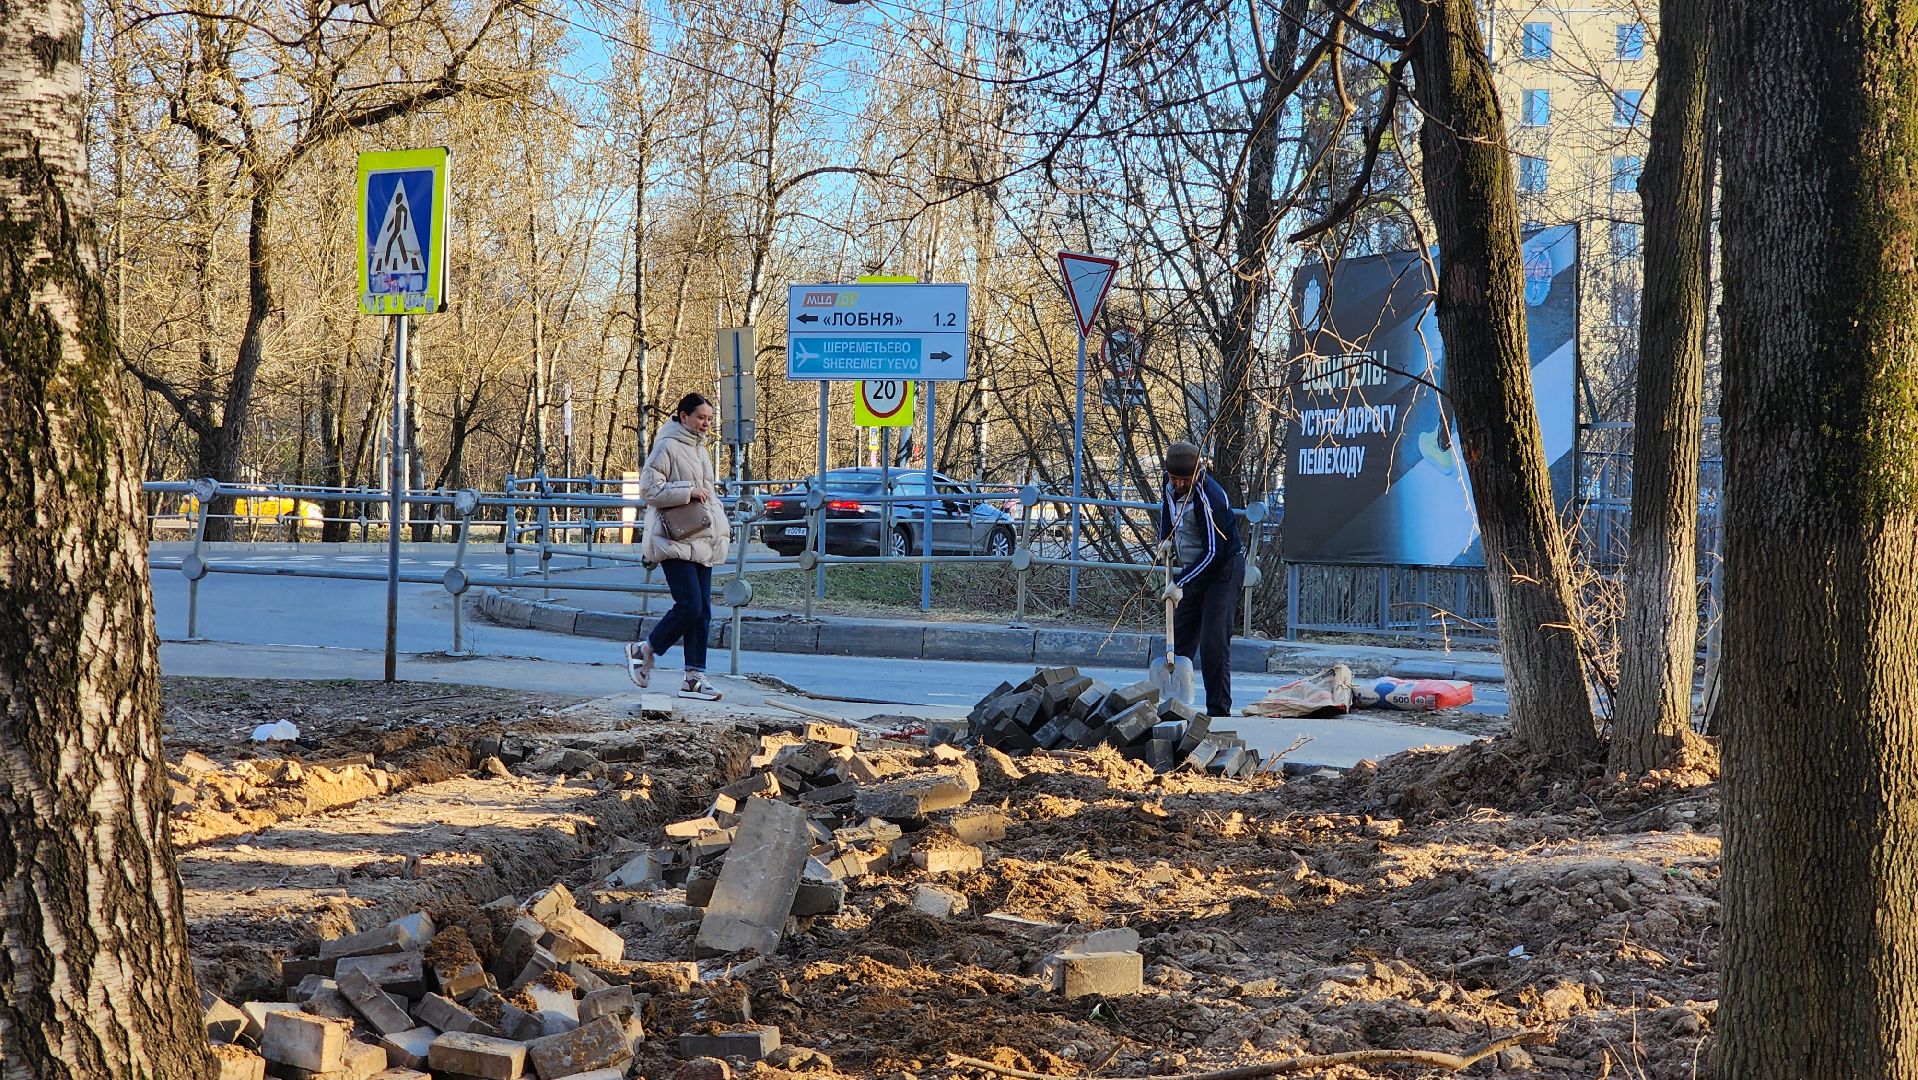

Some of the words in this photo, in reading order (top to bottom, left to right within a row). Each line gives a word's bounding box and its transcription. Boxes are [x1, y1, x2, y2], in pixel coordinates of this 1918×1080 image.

[806, 295, 833, 305] МЦД
[823, 312, 903, 327] «ЛОБНЯ»
[933, 312, 957, 327] 1.2
[823, 341, 911, 354] ШЕРЕМЕТЬЕВО
[873, 380, 896, 400] 20
[1301, 408, 1344, 436] УСТУПИ
[1345, 404, 1397, 439] ДОРОГУ
[1299, 446, 1365, 478] ПЕШЕХОДУ
[1393, 696, 1409, 704] 500
